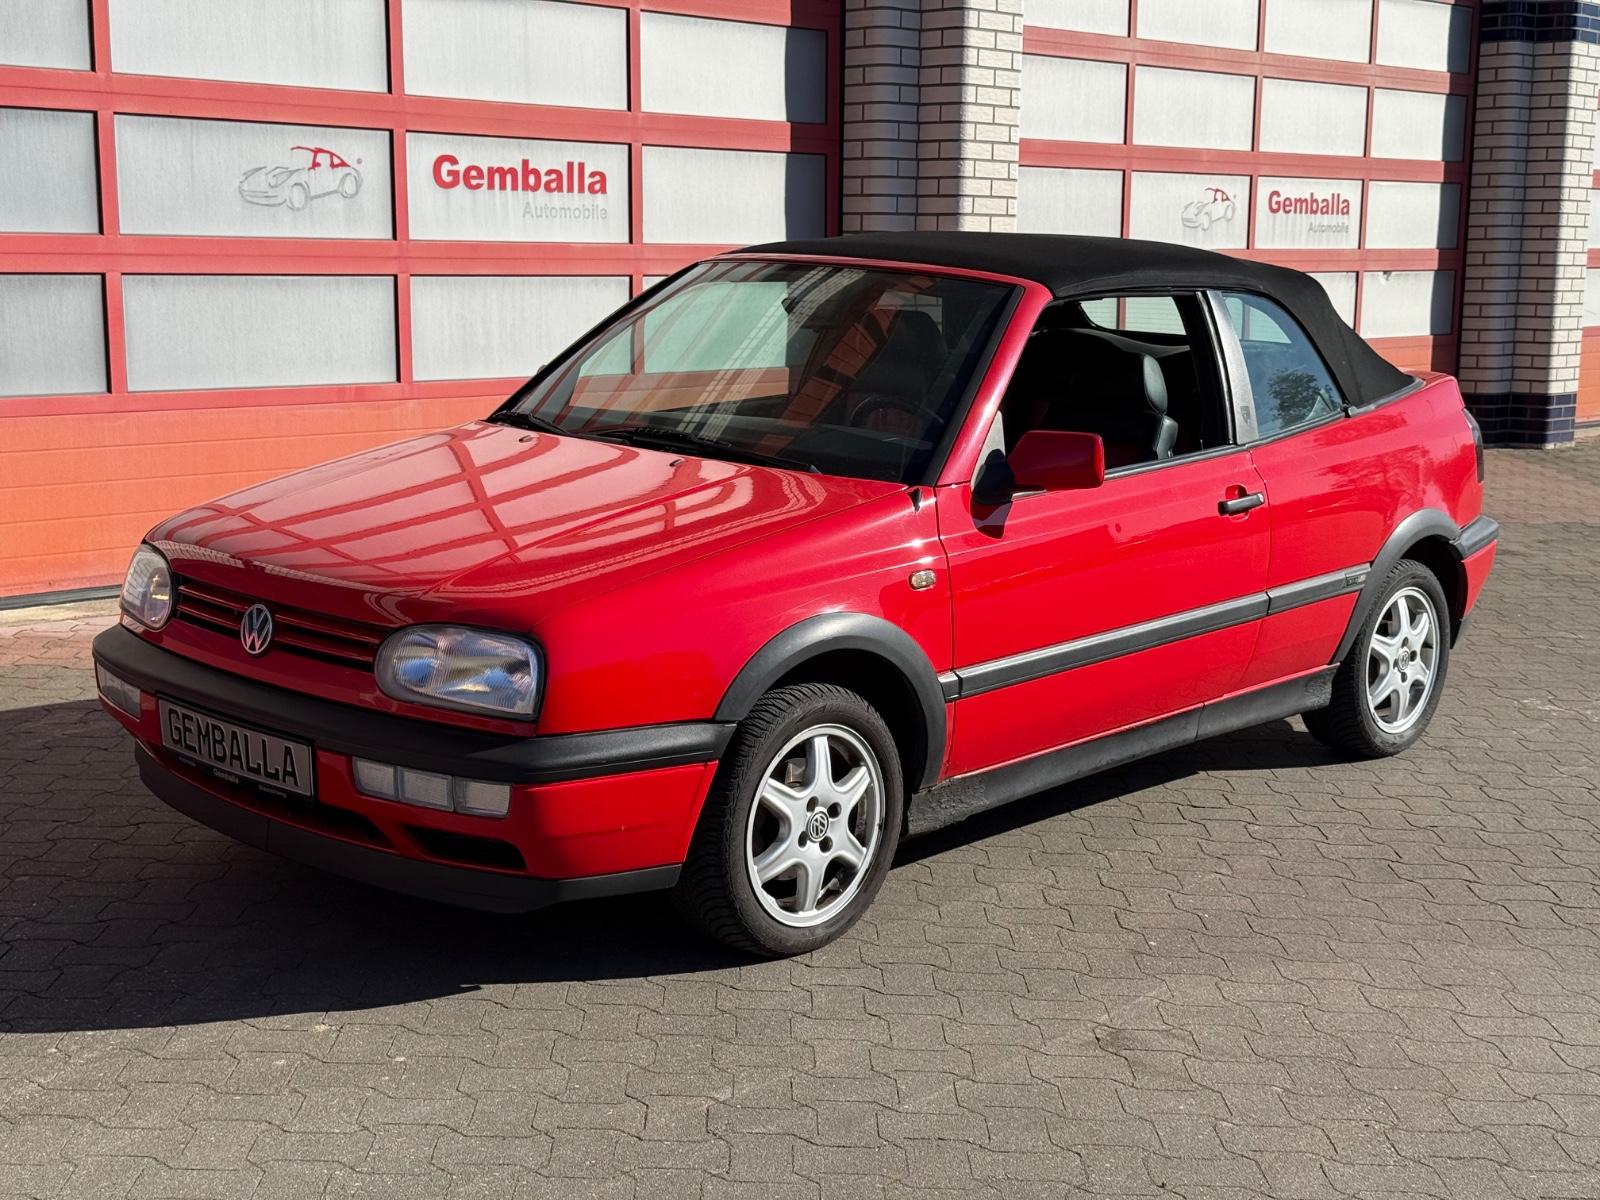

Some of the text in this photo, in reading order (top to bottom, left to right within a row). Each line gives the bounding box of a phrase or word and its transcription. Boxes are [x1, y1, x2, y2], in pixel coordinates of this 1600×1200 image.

[433, 154, 608, 195] Gemballa
[522, 201, 608, 221] Automobile
[1269, 190, 1350, 216] Gemballa
[1308, 222, 1350, 234] Automobile
[168, 708, 300, 788] GEMBALLA
